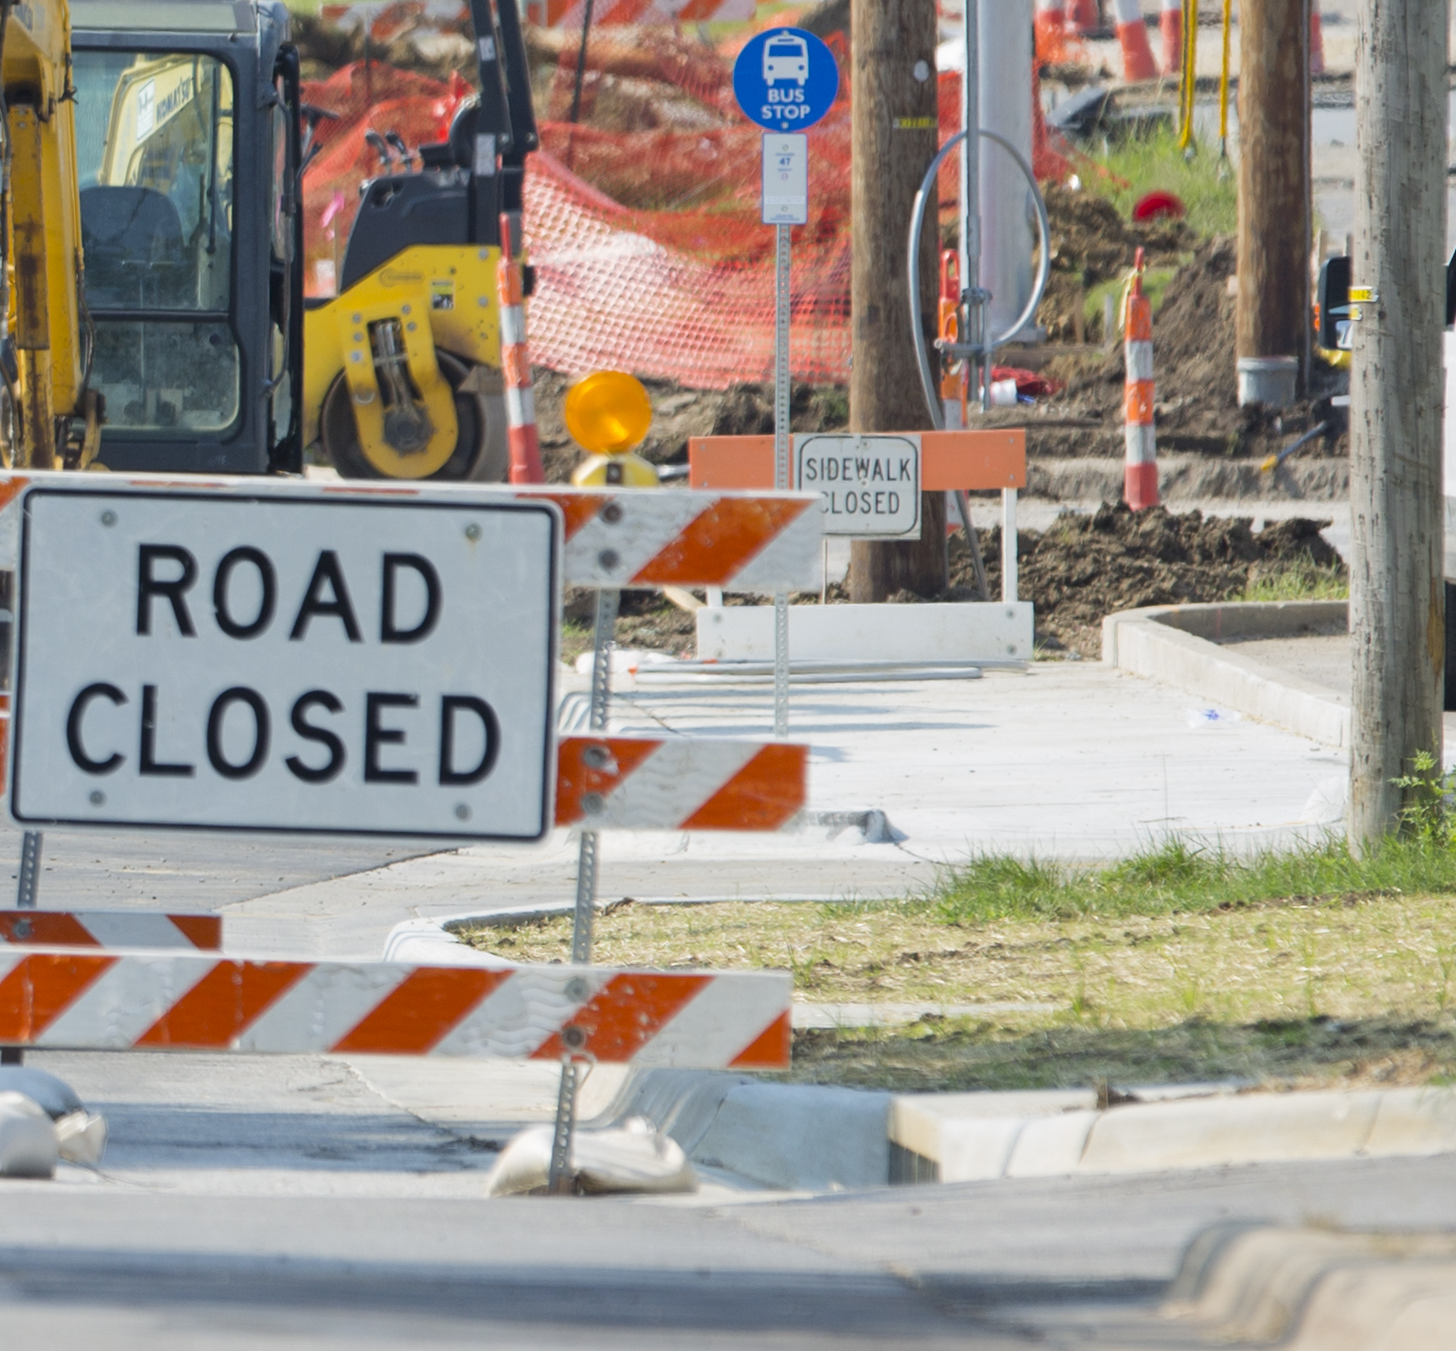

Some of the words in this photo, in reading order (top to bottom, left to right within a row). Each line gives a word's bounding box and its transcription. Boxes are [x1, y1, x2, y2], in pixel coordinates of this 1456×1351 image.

[768, 89, 805, 103] BUS
[761, 104, 810, 119] STOP
[779, 157, 791, 166] 47
[806, 457, 911, 481] SIDEWALK
[136, 543, 443, 645] ROAD
[66, 682, 501, 787] CLOSED
